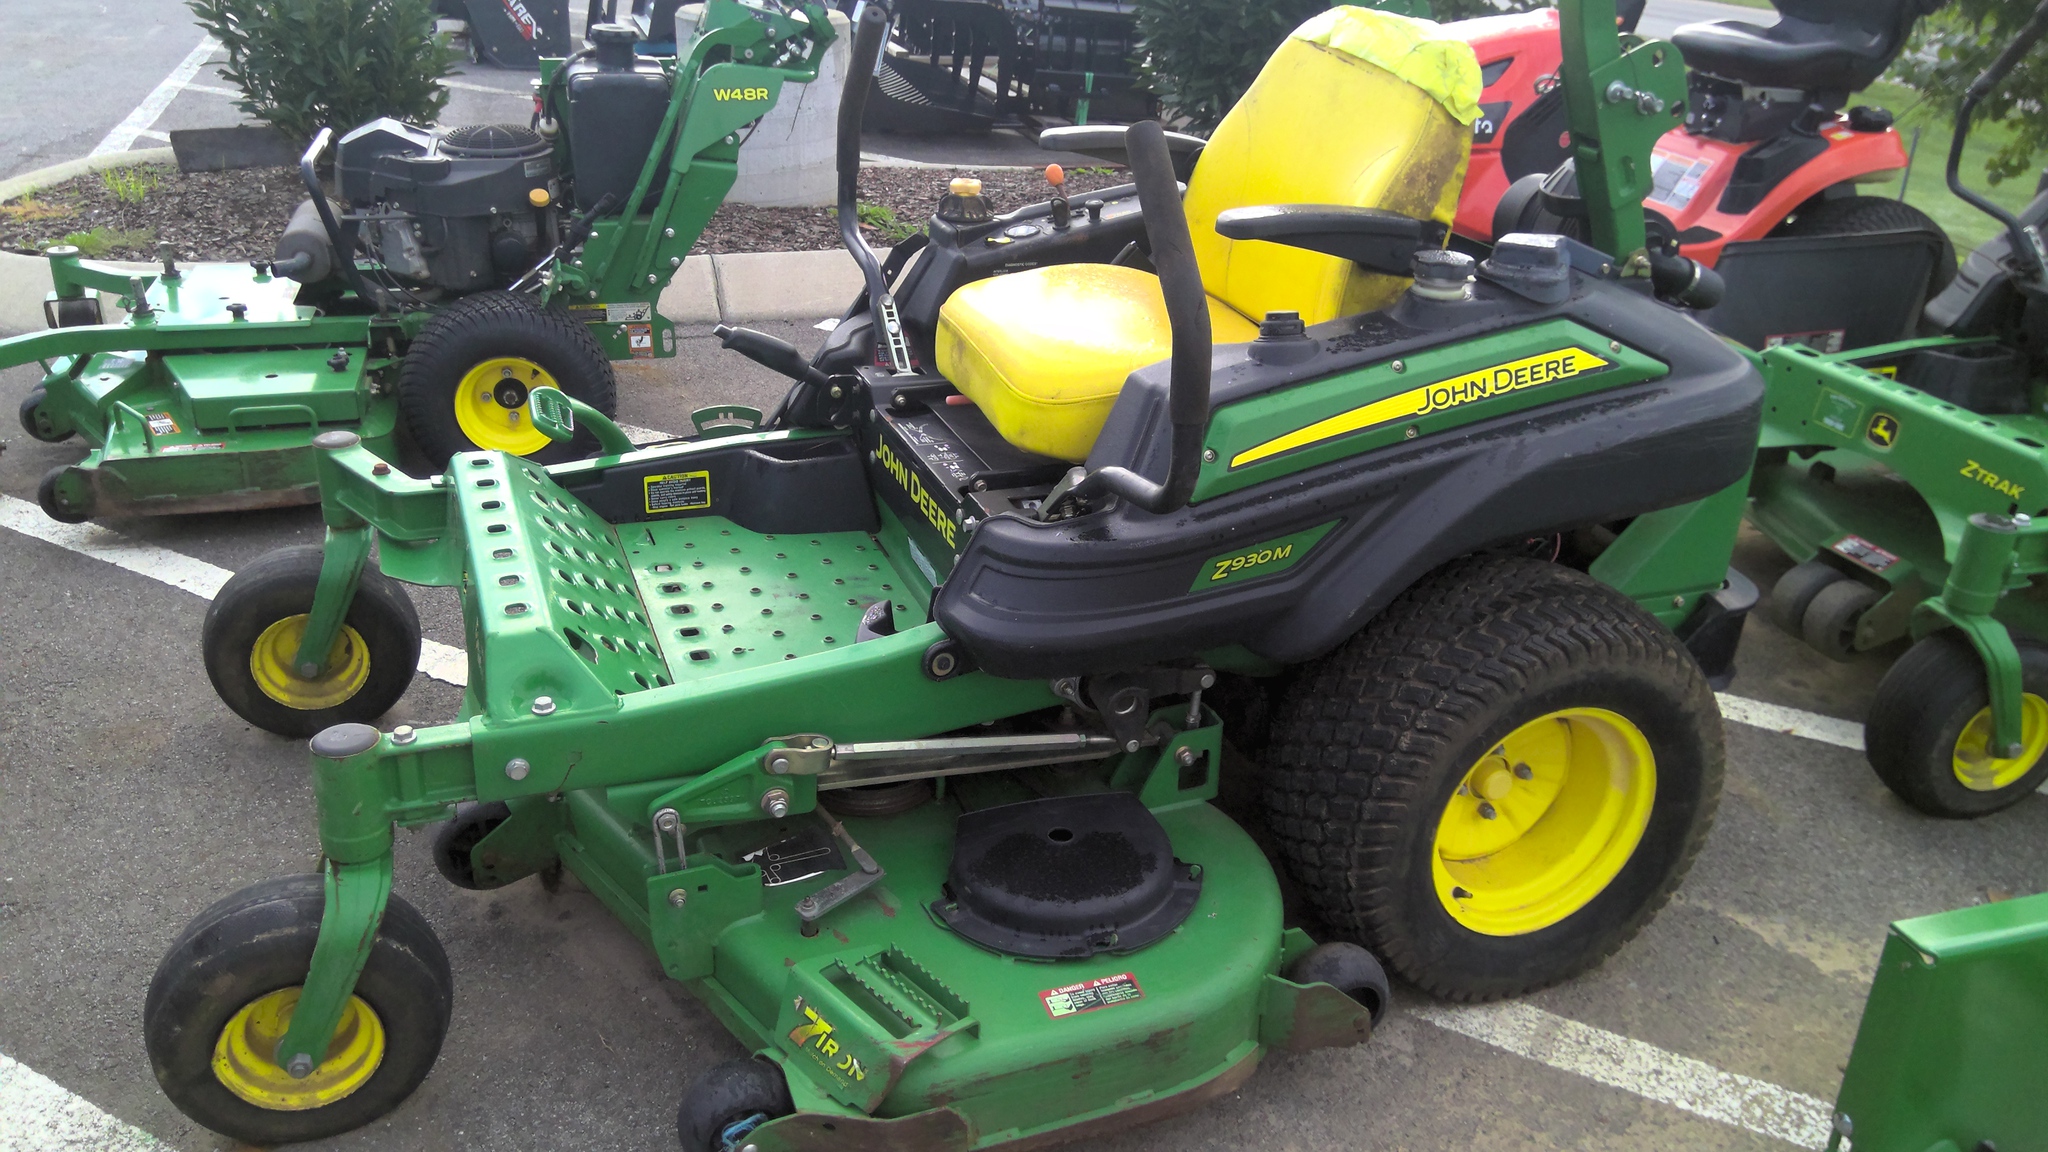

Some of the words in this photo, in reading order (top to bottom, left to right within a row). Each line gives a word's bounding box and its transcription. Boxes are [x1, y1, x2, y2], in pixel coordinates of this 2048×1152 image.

[713, 88, 769, 101] W48R
[1418, 378, 1486, 412] JOHN
[1494, 356, 1576, 391] DEERE
[876, 433, 908, 491] JOHN
[910, 470, 957, 549] DEERE
[1960, 459, 2025, 500] ZTRAK
[1211, 544, 1293, 580] Z930M
[1058, 984, 1084, 993] DANGER
[1101, 974, 1127, 984] PELIGRO
